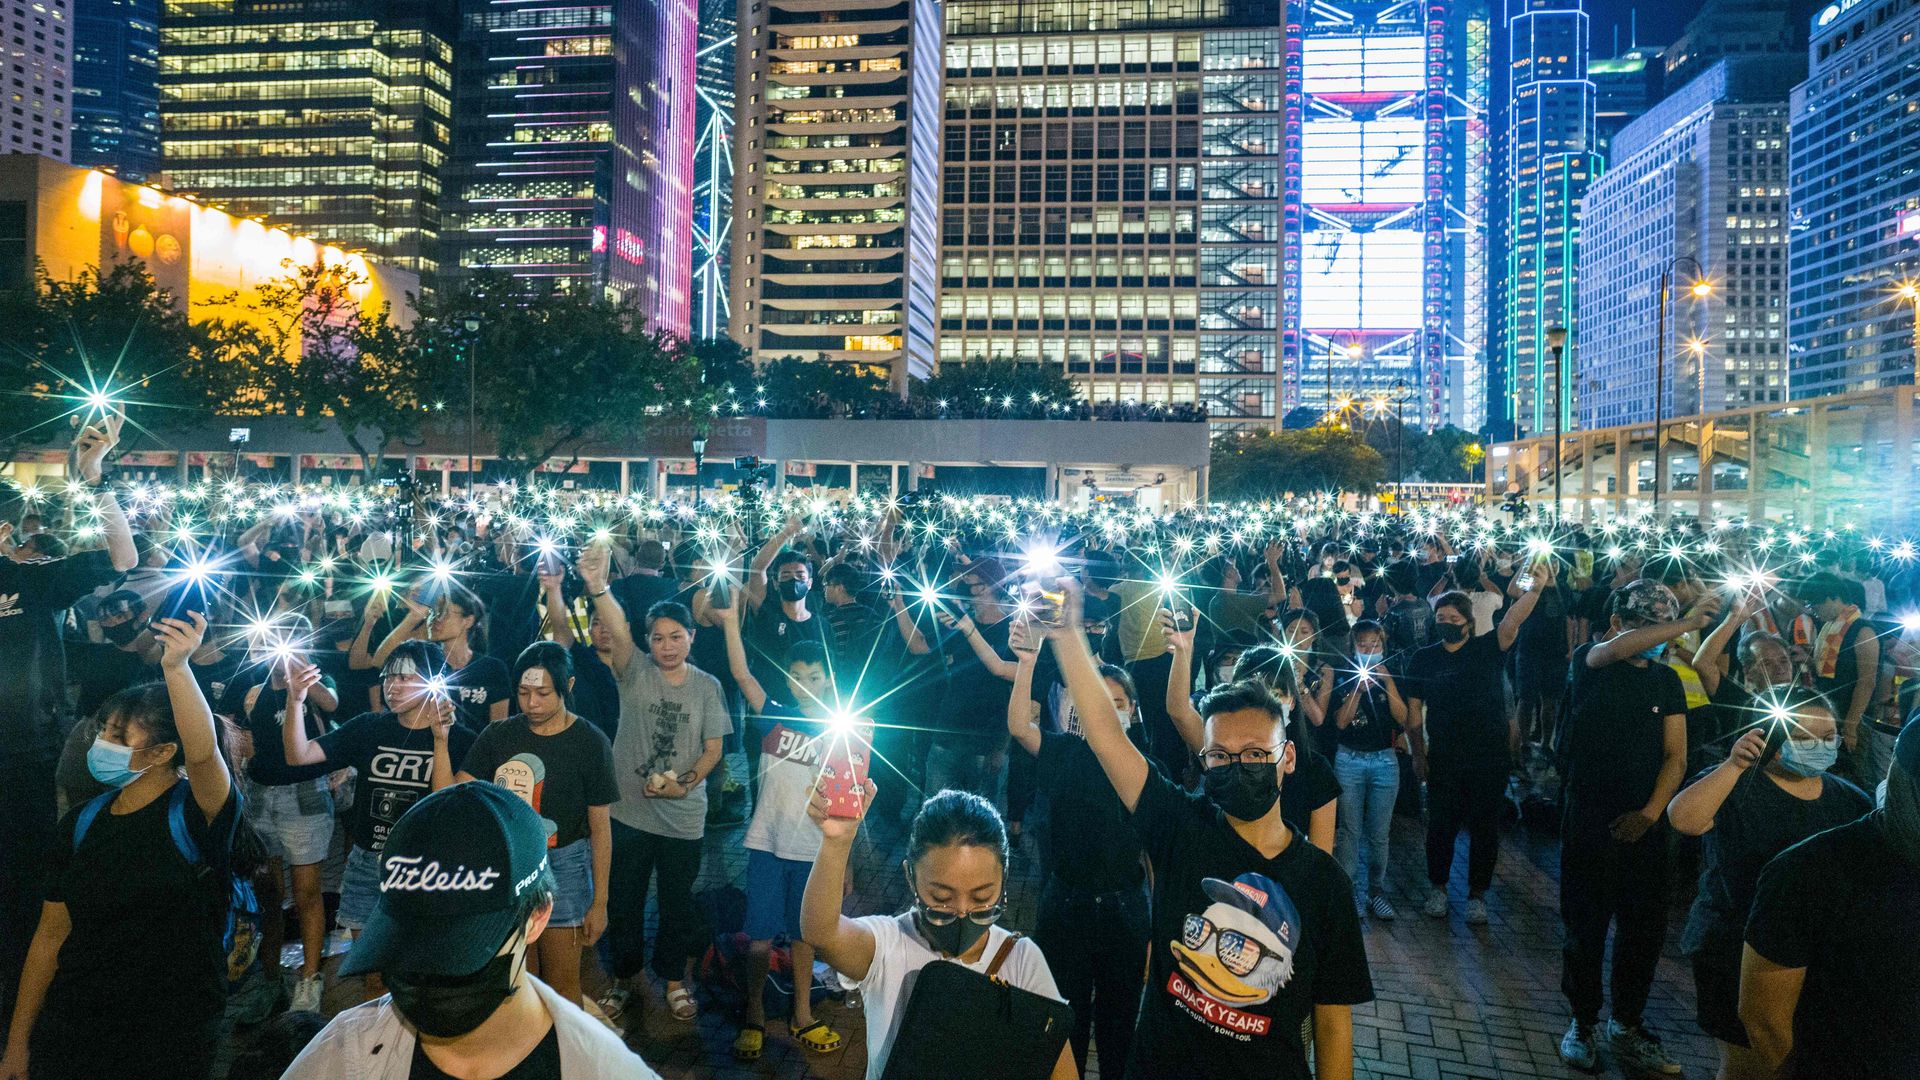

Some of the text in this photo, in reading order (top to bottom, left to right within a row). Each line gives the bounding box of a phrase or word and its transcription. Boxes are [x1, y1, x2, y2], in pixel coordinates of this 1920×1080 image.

[776, 730, 821, 765] PUM
[380, 855, 500, 893] Titleist
[514, 868, 539, 897] PRO
[1172, 978, 1266, 1034] QUACK YEAHS
